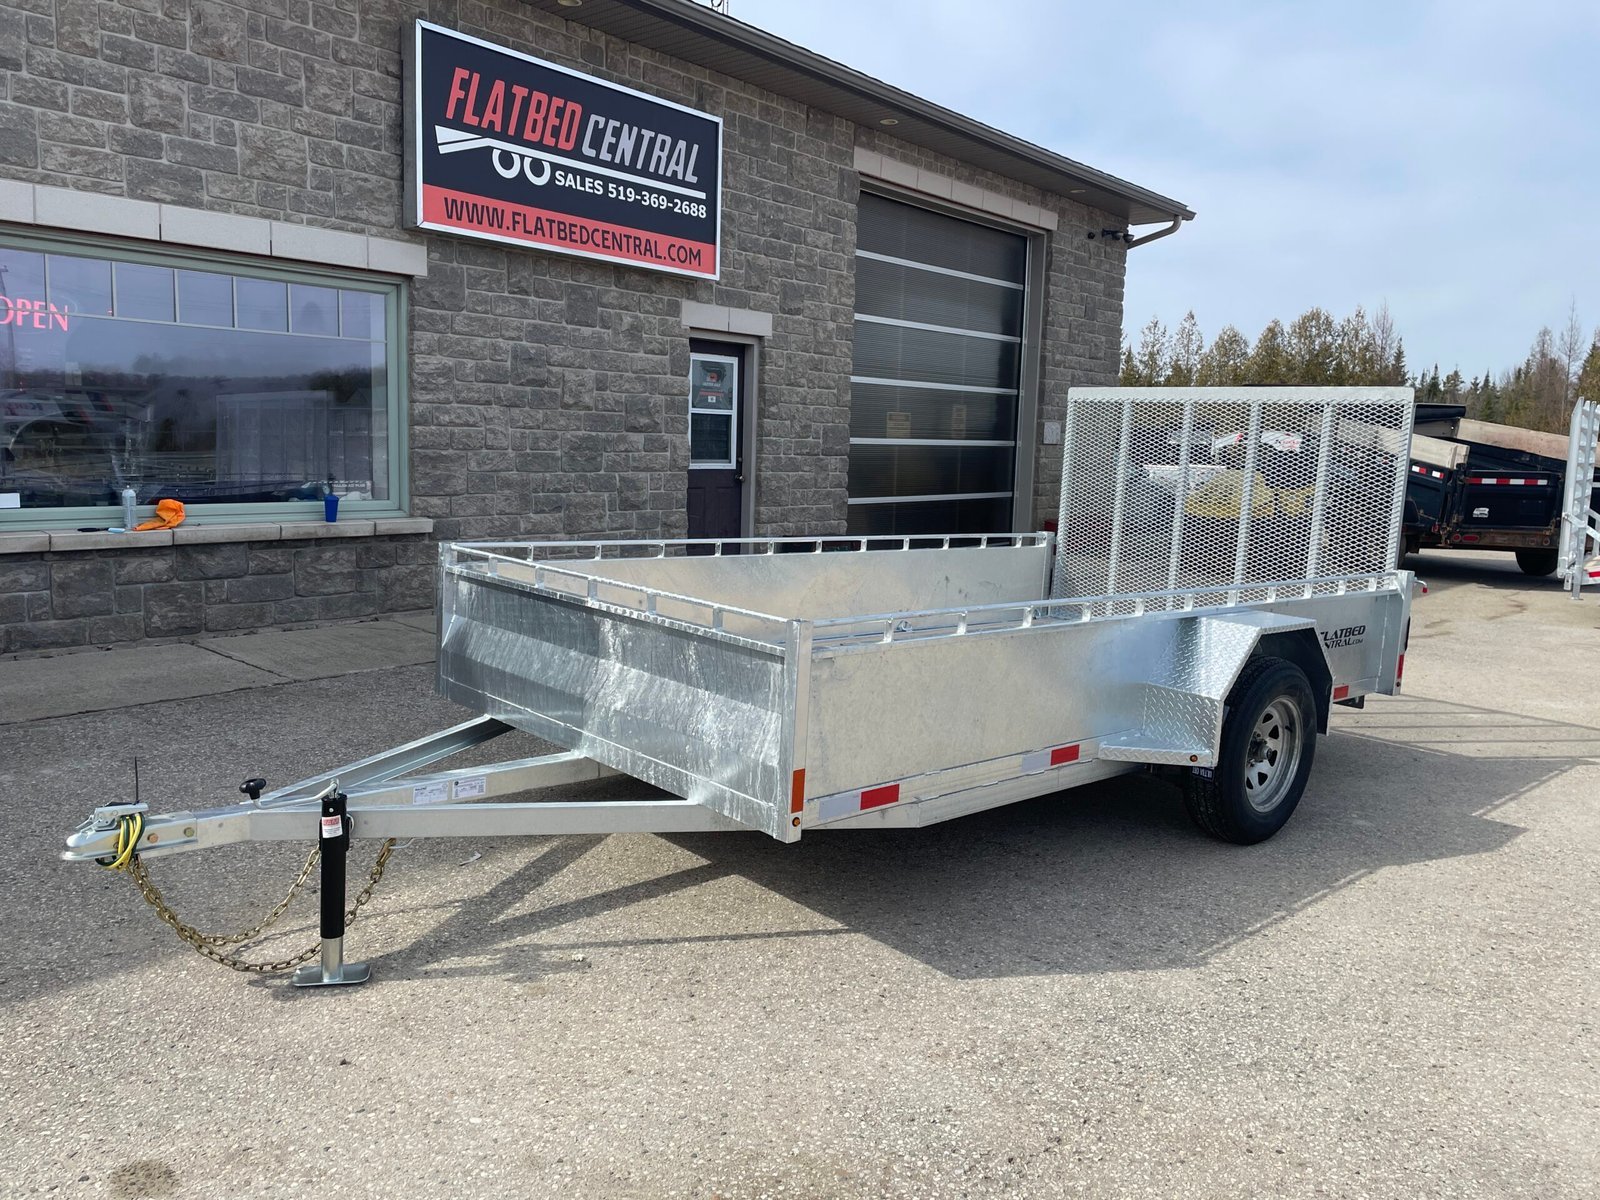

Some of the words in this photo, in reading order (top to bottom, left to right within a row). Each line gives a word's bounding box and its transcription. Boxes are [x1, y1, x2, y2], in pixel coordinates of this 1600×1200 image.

[445, 66, 583, 151] FLATBED
[581, 113, 699, 184] CENTRAL
[555, 170, 604, 195] SALES
[608, 183, 707, 219] 519-369-2688
[443, 196, 702, 267] WWW.FLATBEDCENTRAL.COM
